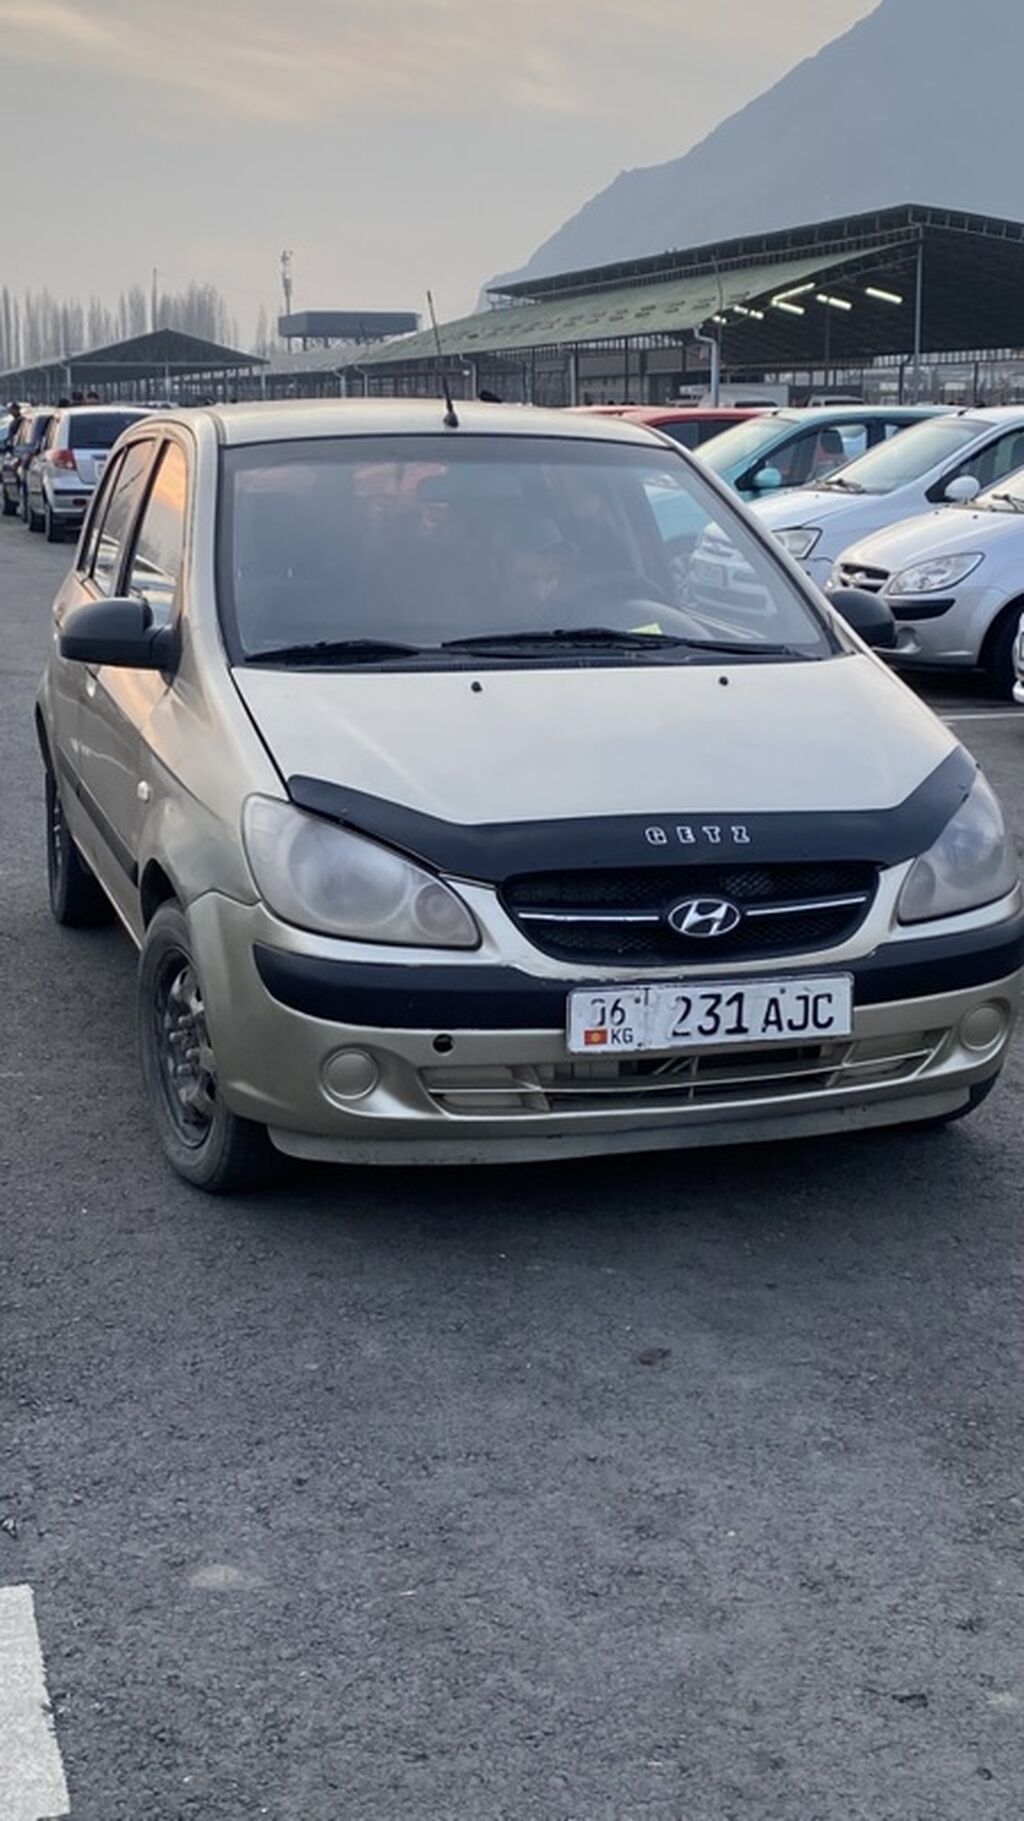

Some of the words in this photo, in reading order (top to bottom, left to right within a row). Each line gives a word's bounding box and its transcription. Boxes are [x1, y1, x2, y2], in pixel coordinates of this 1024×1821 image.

[645, 826, 751, 845] GETZ
[671, 991, 749, 1037] 231
[761, 993, 834, 1033] AJC
[610, 1027, 634, 1045] KG
